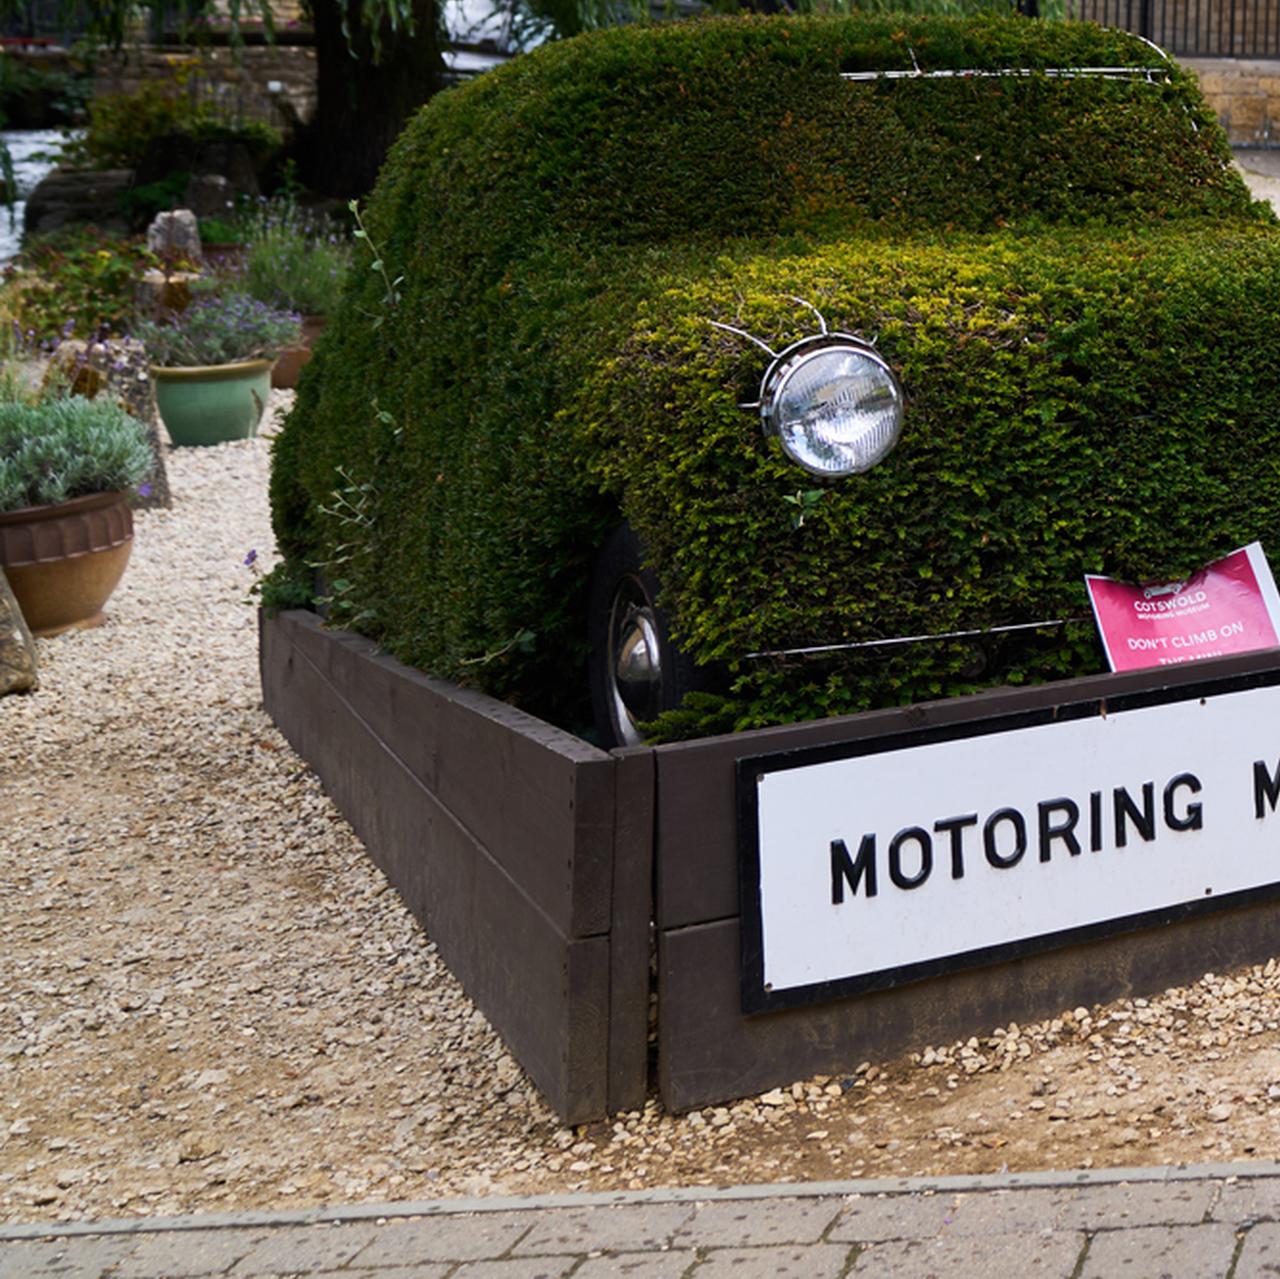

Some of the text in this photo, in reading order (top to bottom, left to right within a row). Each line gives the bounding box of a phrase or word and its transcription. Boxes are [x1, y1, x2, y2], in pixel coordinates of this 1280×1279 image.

[1133, 591, 1207, 613] COTSWOLD
[1127, 620, 1245, 650] DON'T CLIMB ON
[829, 772, 1203, 905] MOTORING
